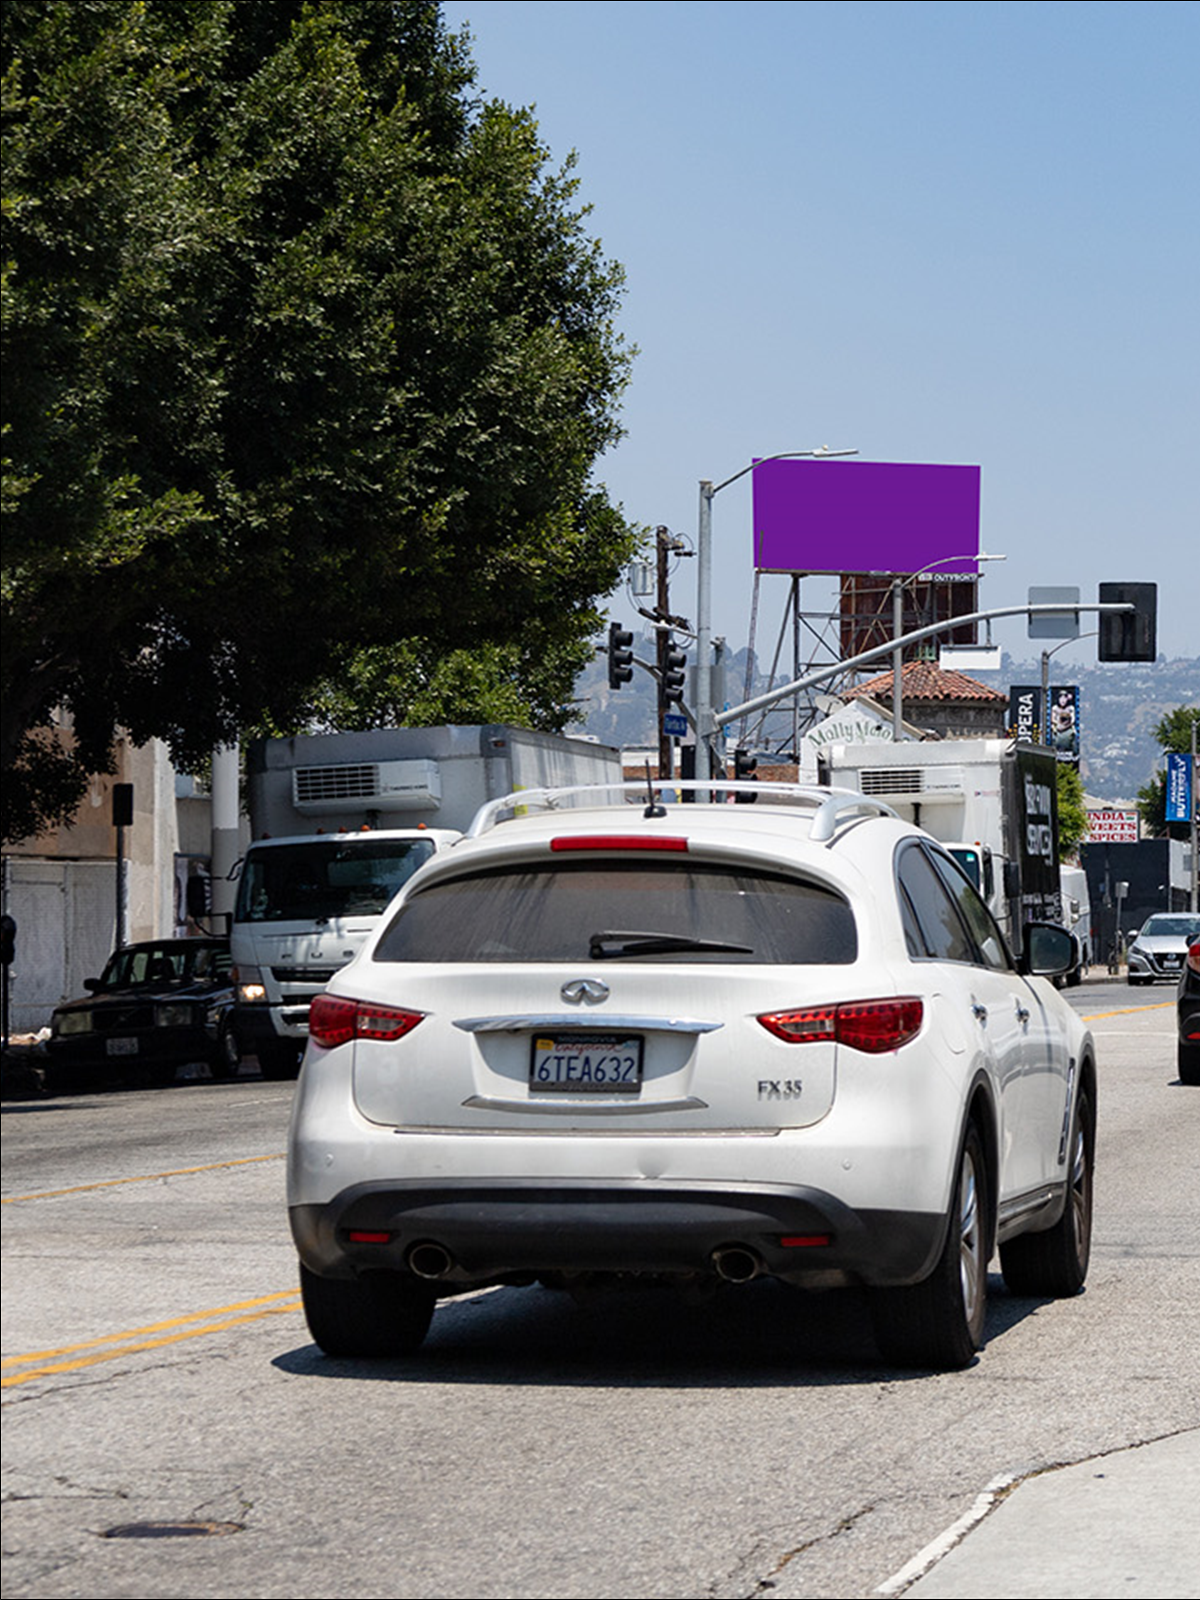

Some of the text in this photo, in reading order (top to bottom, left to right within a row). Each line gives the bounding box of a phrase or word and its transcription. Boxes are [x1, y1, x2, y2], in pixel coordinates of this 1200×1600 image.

[1087, 812, 1124, 820] INDIA
[1088, 822, 1136, 831] WEETS
[1089, 833, 1136, 842] SPICES
[538, 1056, 635, 1082] 6TEA632
